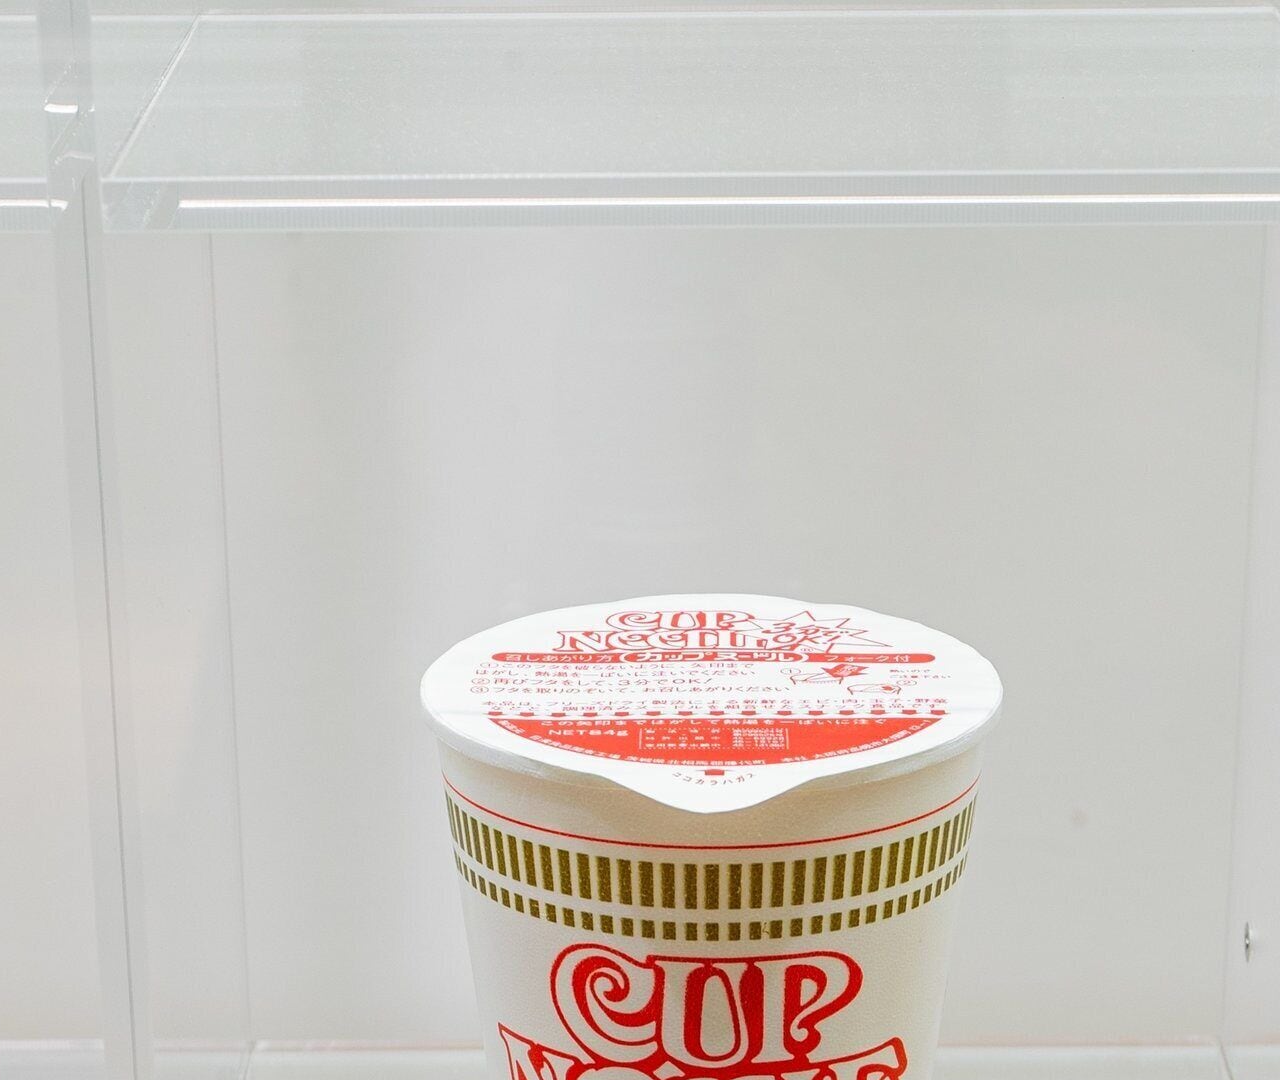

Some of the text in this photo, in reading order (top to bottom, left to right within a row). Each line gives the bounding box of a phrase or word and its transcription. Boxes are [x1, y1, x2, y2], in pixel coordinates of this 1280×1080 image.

[606, 610, 756, 632] CUP
[773, 632, 840, 645] OK!
[504, 653, 616, 663] 召しあがり方
[636, 651, 794, 662] カップヌードル
[823, 654, 911, 663] フォーク付
[550, 942, 864, 1070] CUP
